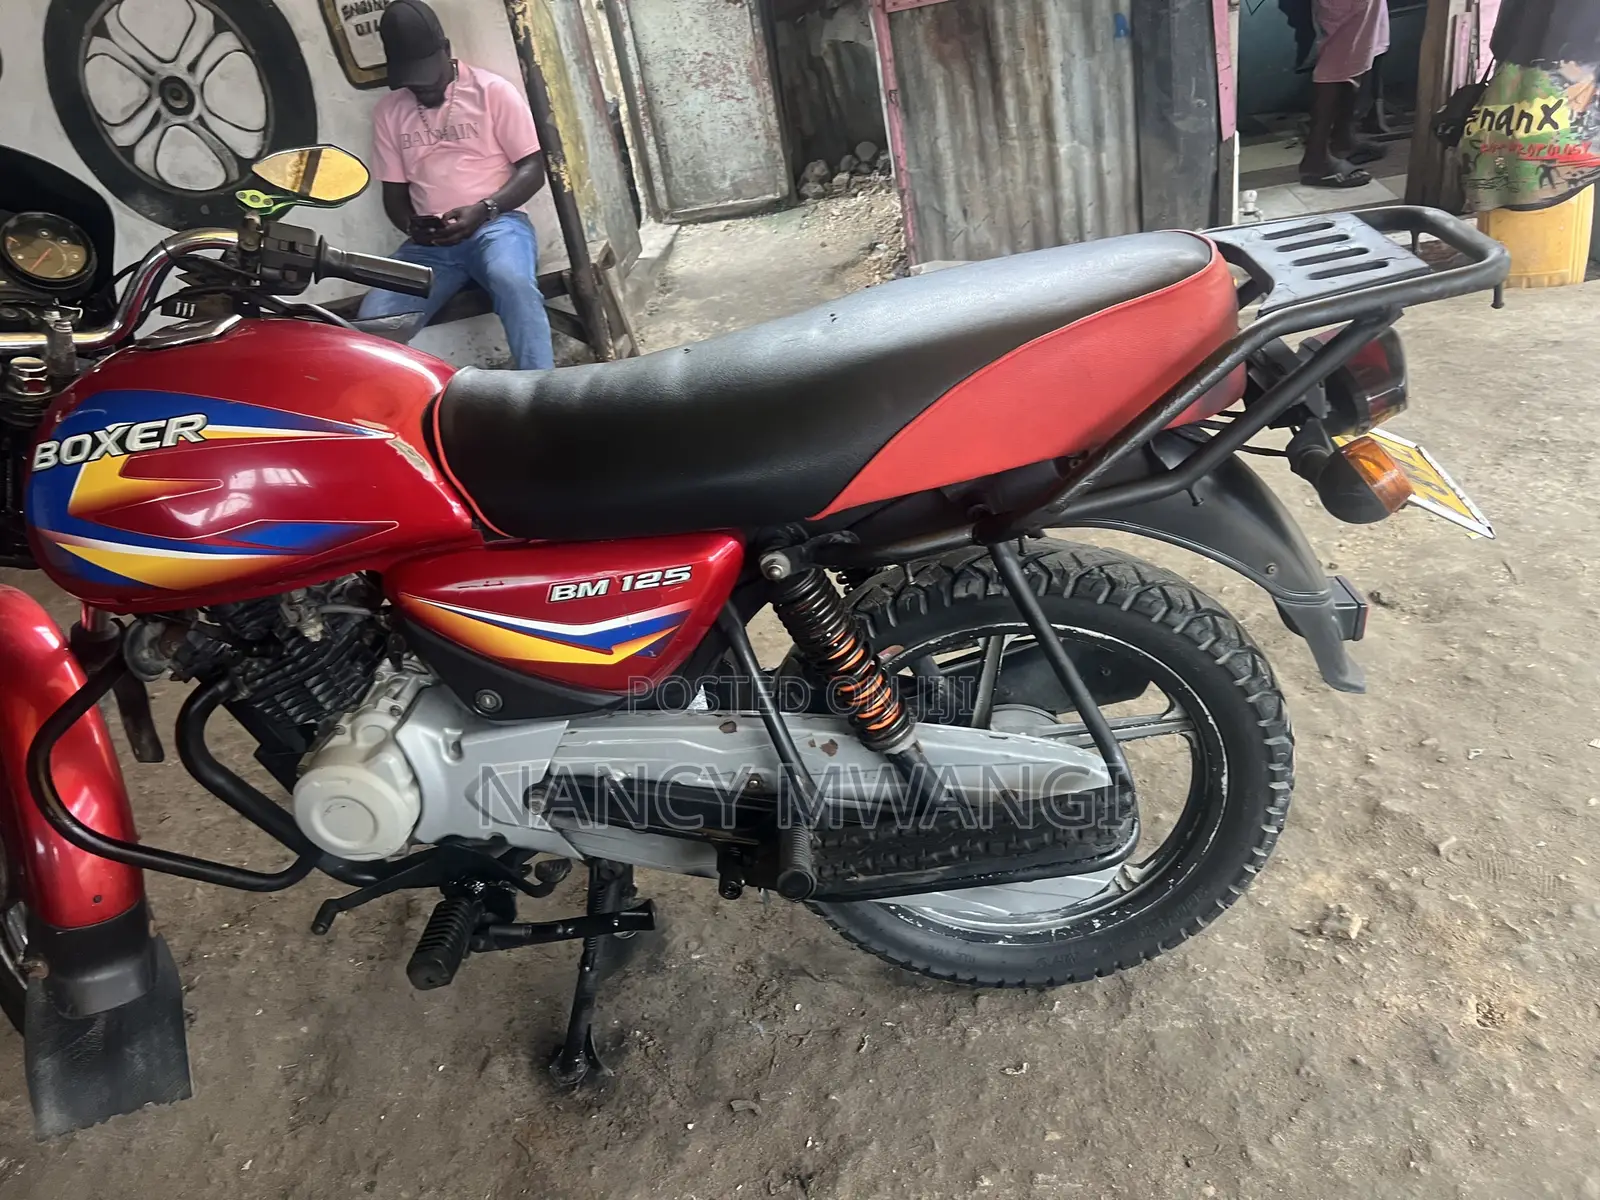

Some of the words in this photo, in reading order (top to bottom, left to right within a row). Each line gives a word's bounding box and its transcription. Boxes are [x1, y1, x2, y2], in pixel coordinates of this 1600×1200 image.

[32, 412, 208, 472] BOXER
[549, 578, 611, 603] BM
[620, 565, 693, 593] 125
